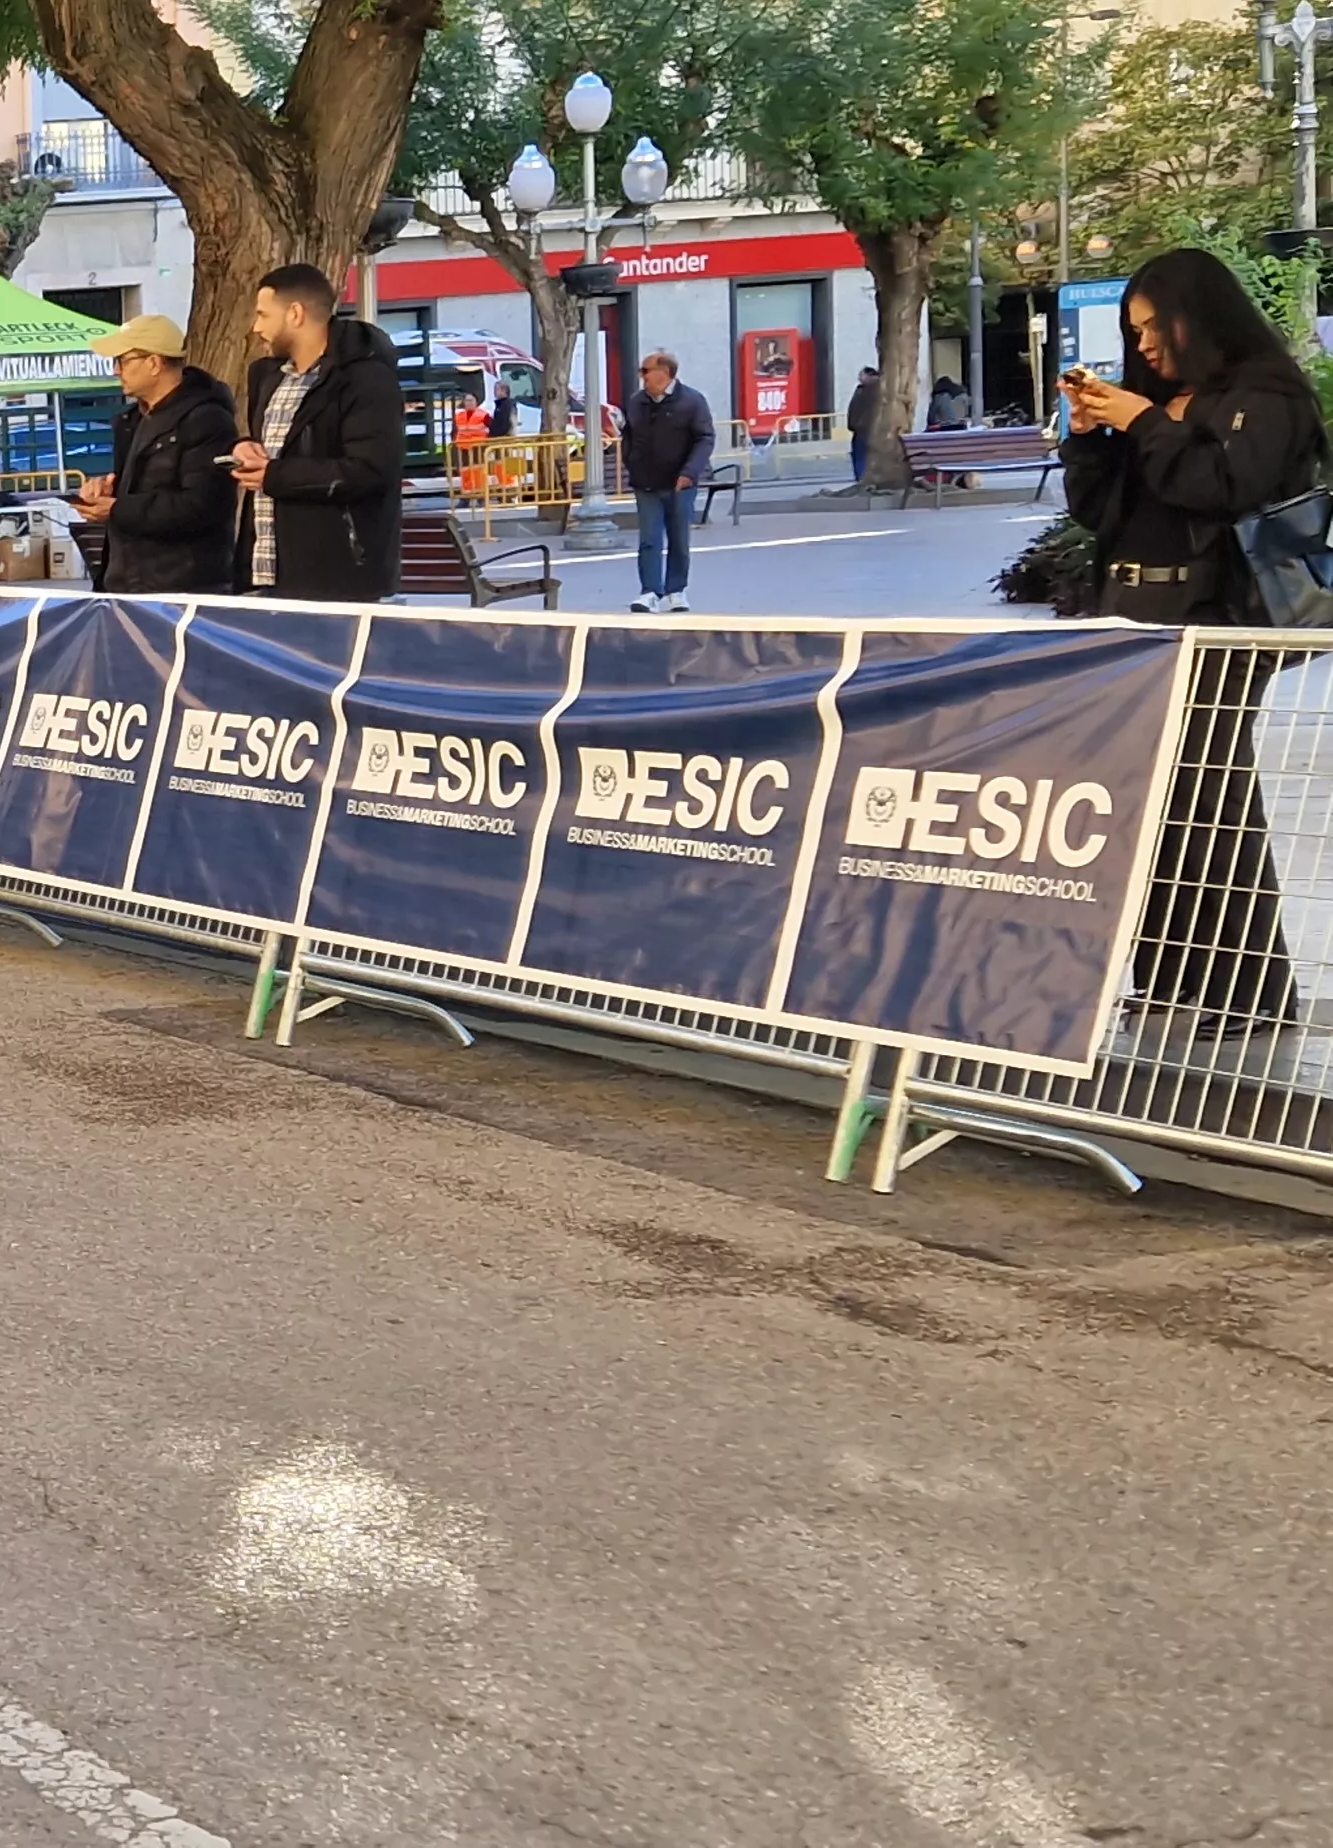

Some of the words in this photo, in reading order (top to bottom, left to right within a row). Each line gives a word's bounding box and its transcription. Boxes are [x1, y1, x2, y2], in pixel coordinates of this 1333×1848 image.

[88, 271, 97, 286] 2
[0, 333, 89, 346] SPORT
[47, 694, 148, 761] ESIC
[206, 711, 320, 784] ESIC
[393, 730, 527, 809] ESIC
[624, 750, 790, 836] ESIC
[346, 798, 517, 837] BUSINESS&MARKETINGSCHOOL
[905, 770, 1114, 868] ESIC
[566, 826, 776, 867] BUSINESS&MARKETINGSCHOOL
[839, 856, 1097, 903] BUSINESS&MARKETINGSCHOOL
